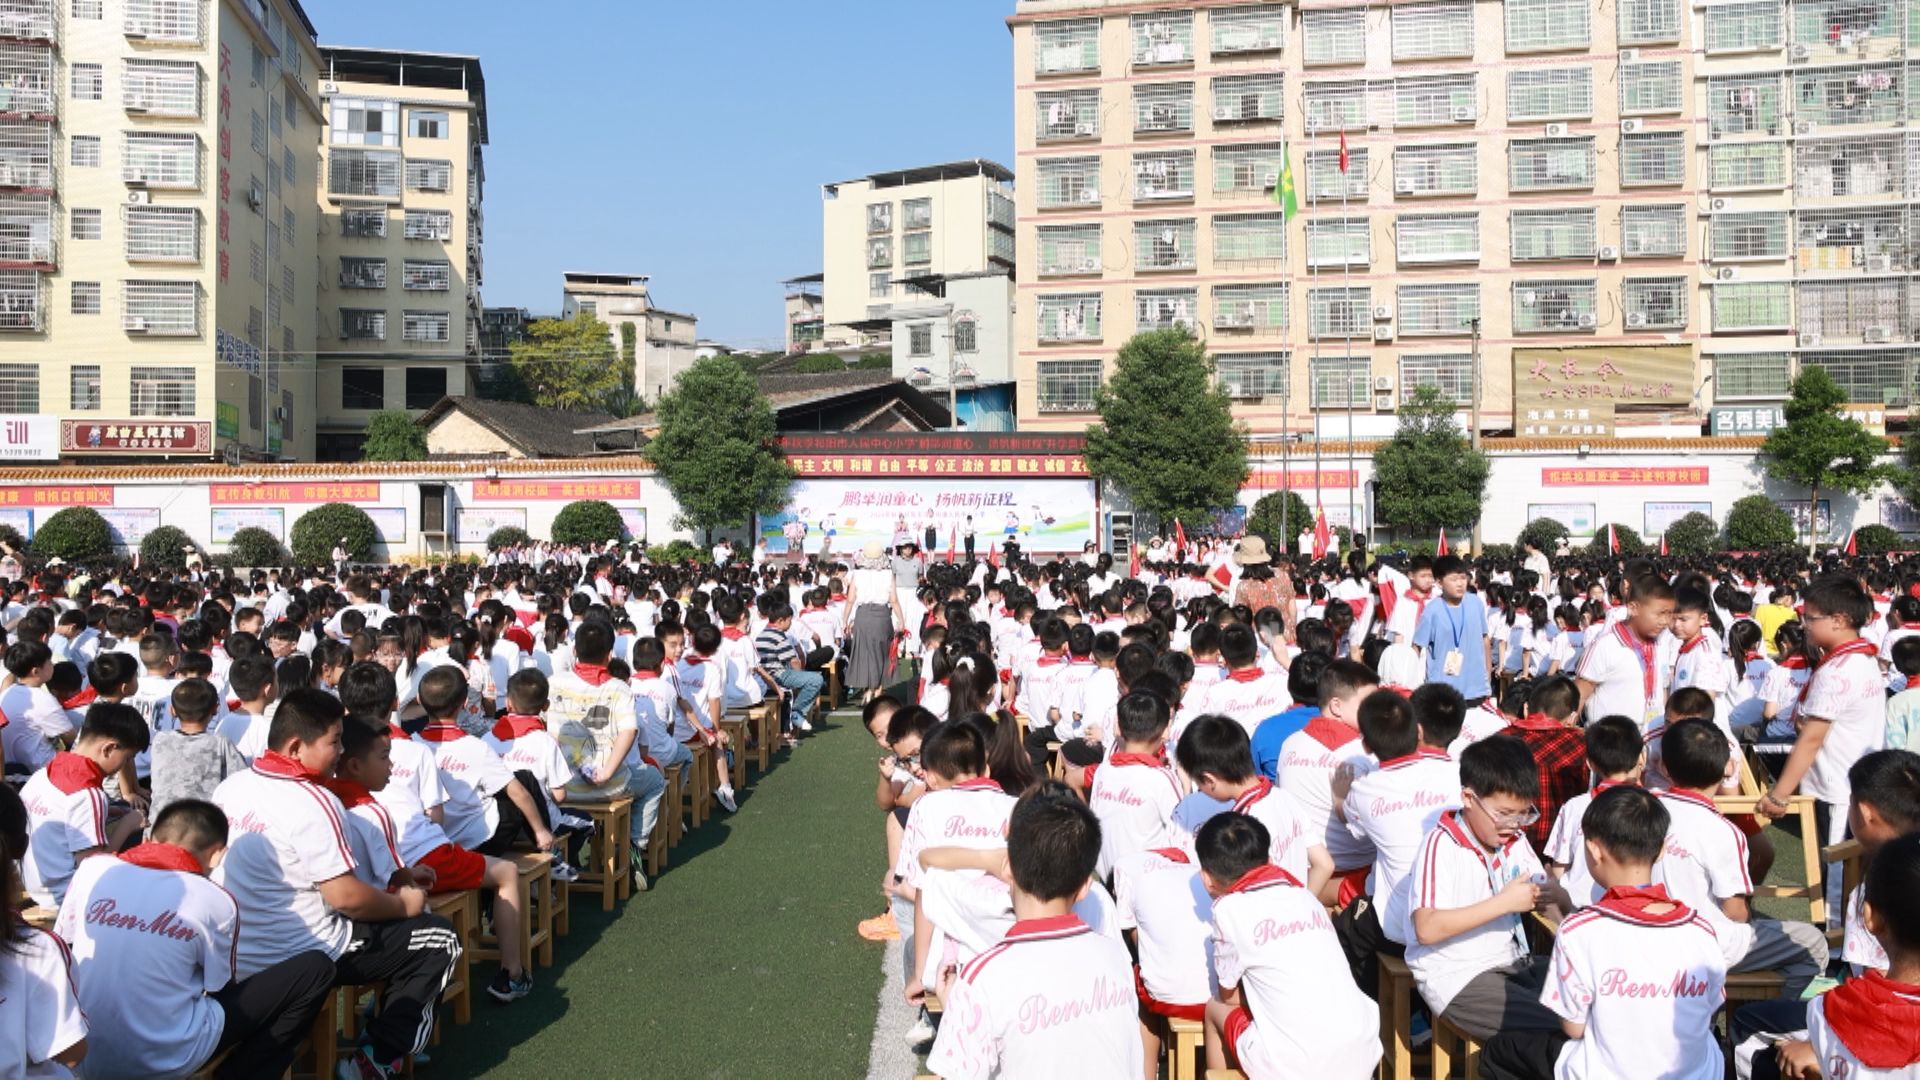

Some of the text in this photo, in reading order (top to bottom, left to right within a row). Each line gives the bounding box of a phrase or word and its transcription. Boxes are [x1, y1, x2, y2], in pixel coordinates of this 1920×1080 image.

[821, 458, 844, 473] 文明
[850, 458, 873, 473] 和谐
[879, 458, 900, 473] 自由
[906, 458, 929, 473] 平等
[934, 458, 957, 473] 公正
[962, 458, 984, 473] 法治
[990, 458, 1012, 473] 爱国
[1017, 458, 1039, 473] 敬业
[1045, 458, 1066, 473] 诚信
[935, 491, 1018, 509] 扬帆新征程
[1114, 787, 1146, 807] Min
[1369, 790, 1450, 818] Ren Min
[943, 814, 992, 839] Ren
[86, 898, 200, 943] Ren Min
[1253, 916, 1308, 947] Ren
[1599, 967, 1709, 999] Ren Min
[1018, 974, 1135, 1035] Ren Min
